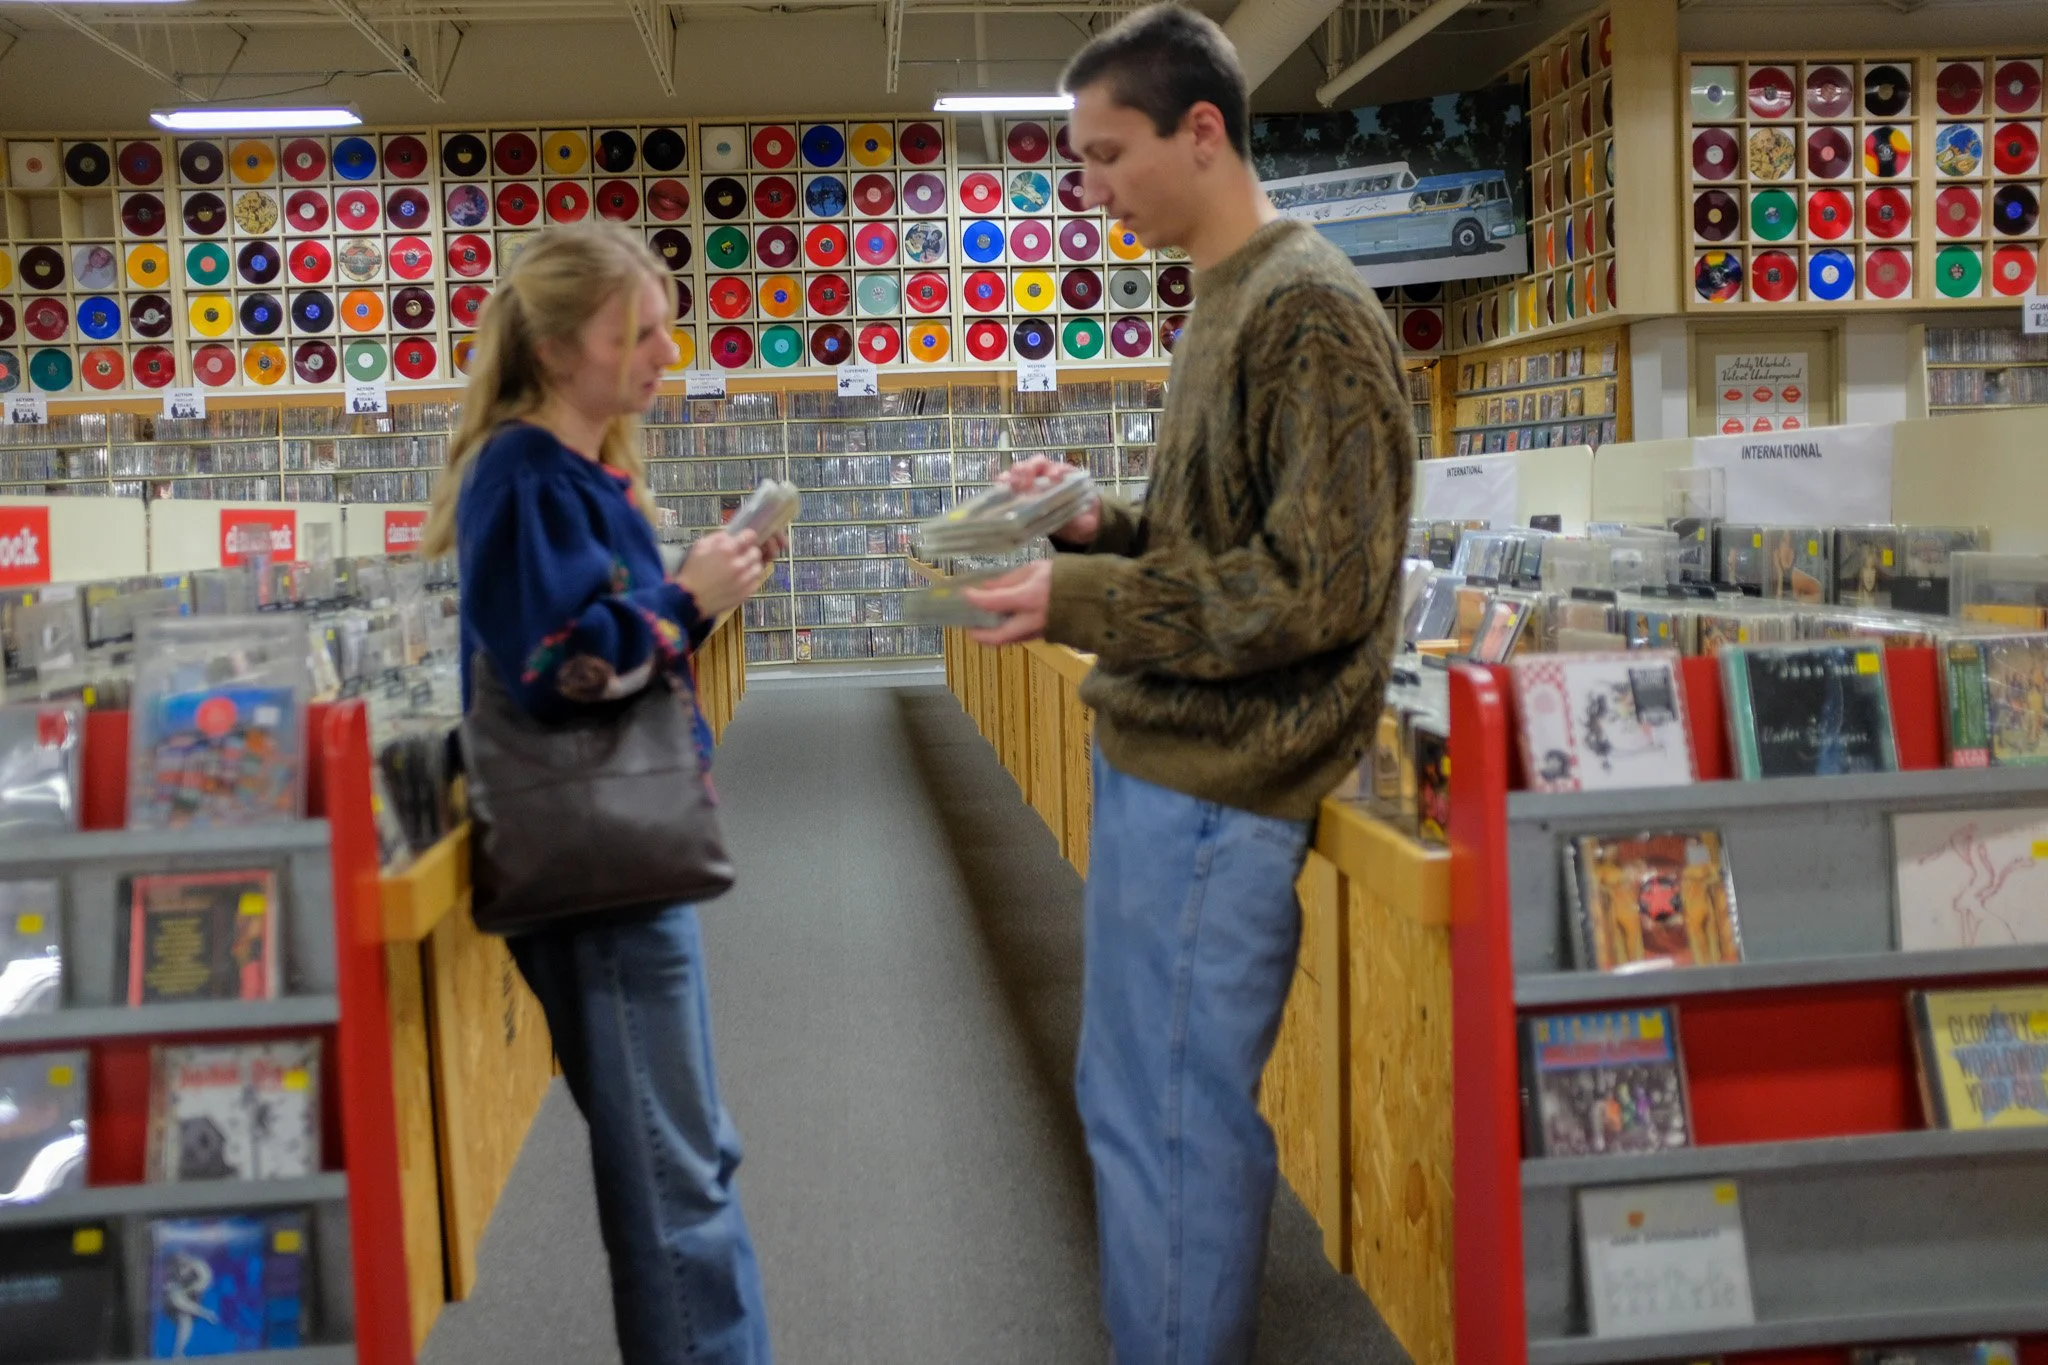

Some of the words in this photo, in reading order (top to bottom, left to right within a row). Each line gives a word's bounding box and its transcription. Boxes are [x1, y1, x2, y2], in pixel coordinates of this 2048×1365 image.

[1729, 357, 1753, 371] Andy
[1755, 356, 1791, 368] Warhol's
[1723, 369, 1748, 381] Velvet
[1751, 368, 1802, 382] Underground
[1741, 443, 1822, 460] INTERNATIONAL
[1446, 465, 1483, 478] INTERNATIONAL
